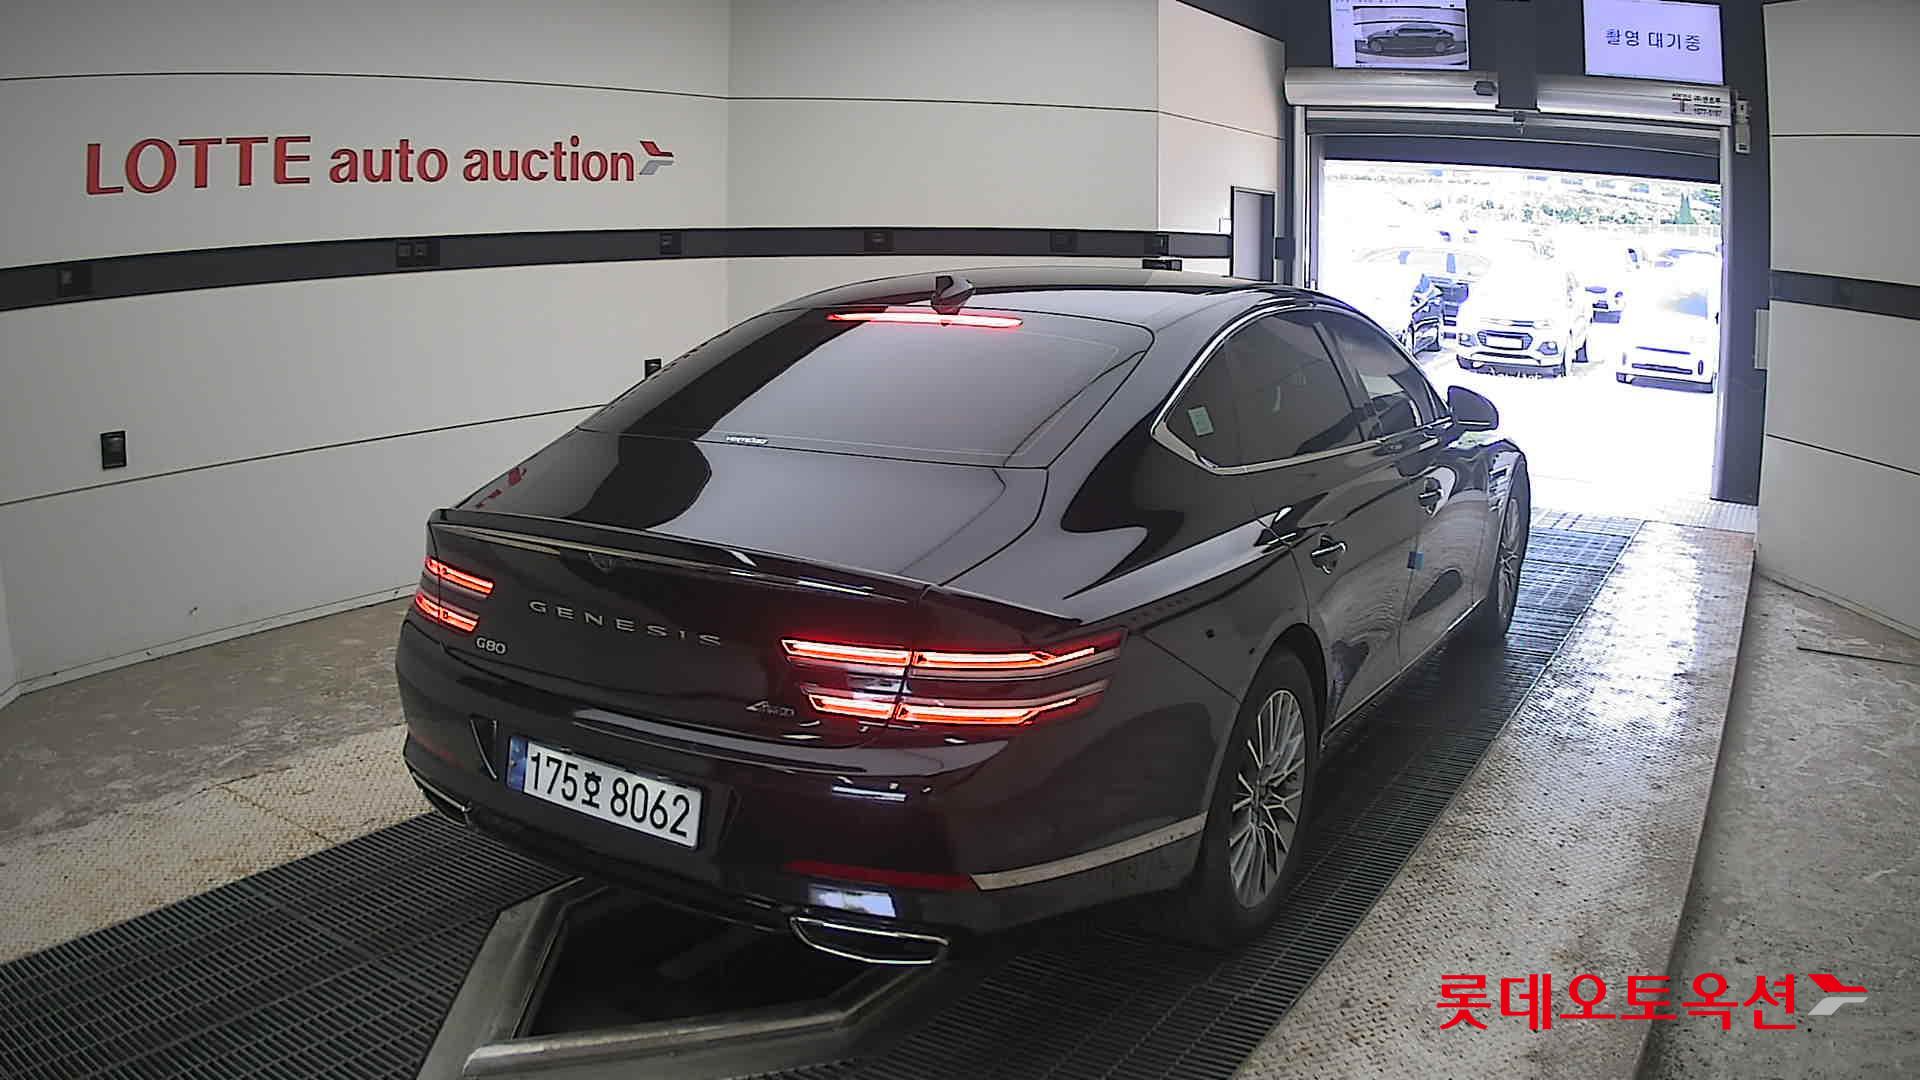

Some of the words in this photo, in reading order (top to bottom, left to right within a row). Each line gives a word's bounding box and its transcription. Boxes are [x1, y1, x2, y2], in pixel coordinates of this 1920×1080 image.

[85, 135, 312, 196] LOTTE
[328, 138, 448, 184] auto
[461, 135, 635, 183] auction
[475, 636, 507, 655] G80
[528, 600, 722, 646] GENESIS
[530, 752, 602, 809] 175호
[610, 777, 691, 839] 8062
